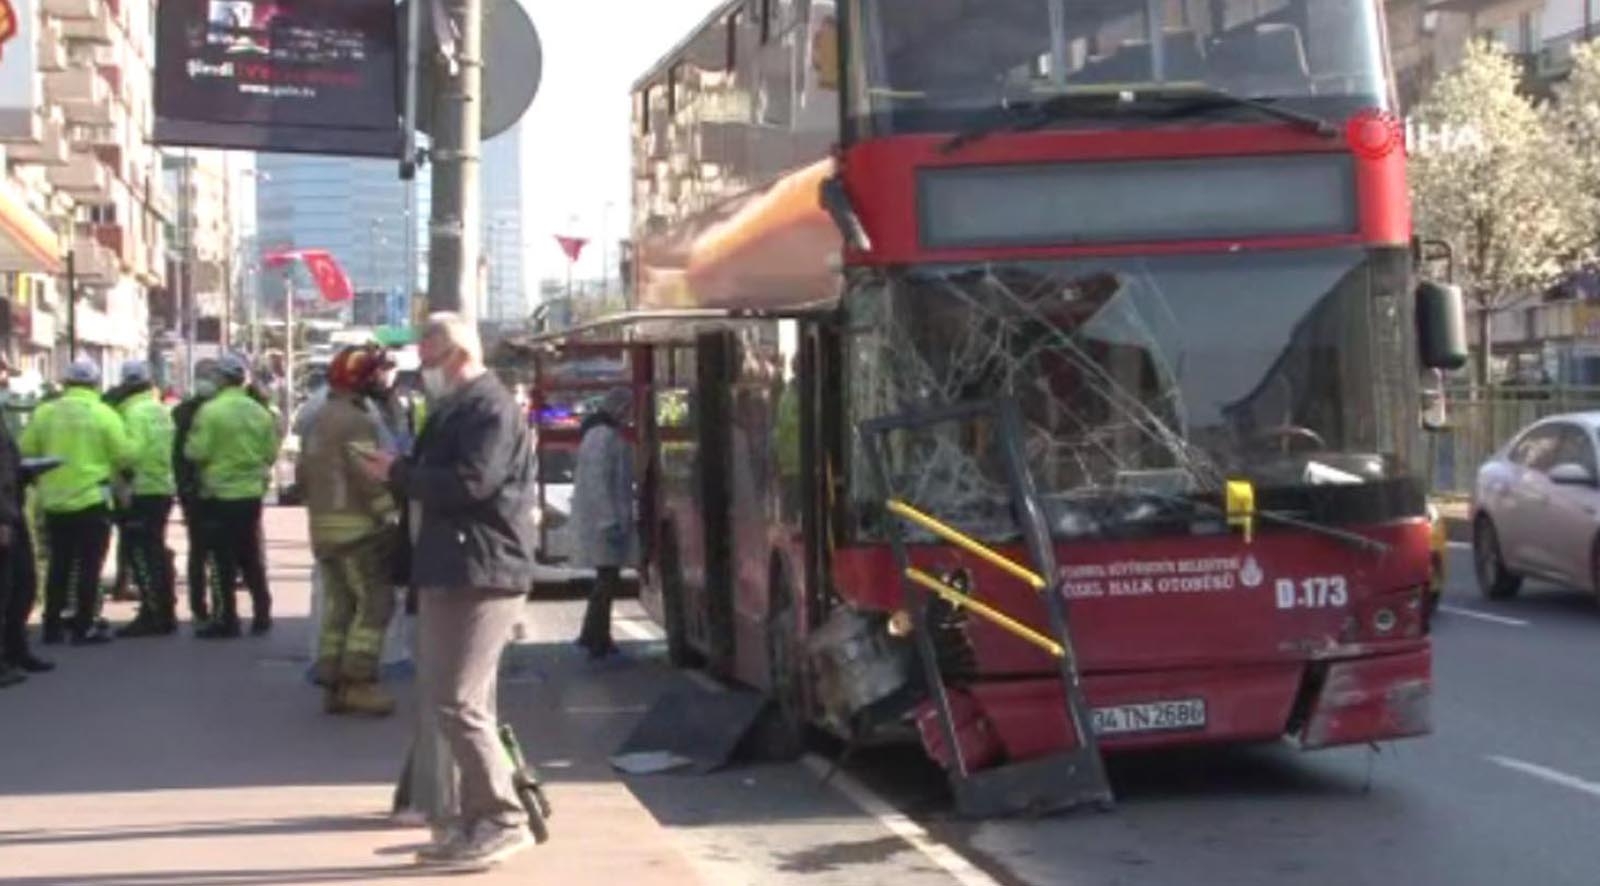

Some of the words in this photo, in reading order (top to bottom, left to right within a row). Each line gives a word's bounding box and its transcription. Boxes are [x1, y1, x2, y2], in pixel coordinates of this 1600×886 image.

[1109, 579, 1153, 595] HALK
[1275, 575, 1347, 608] D.173
[1120, 705, 1150, 729] TN
